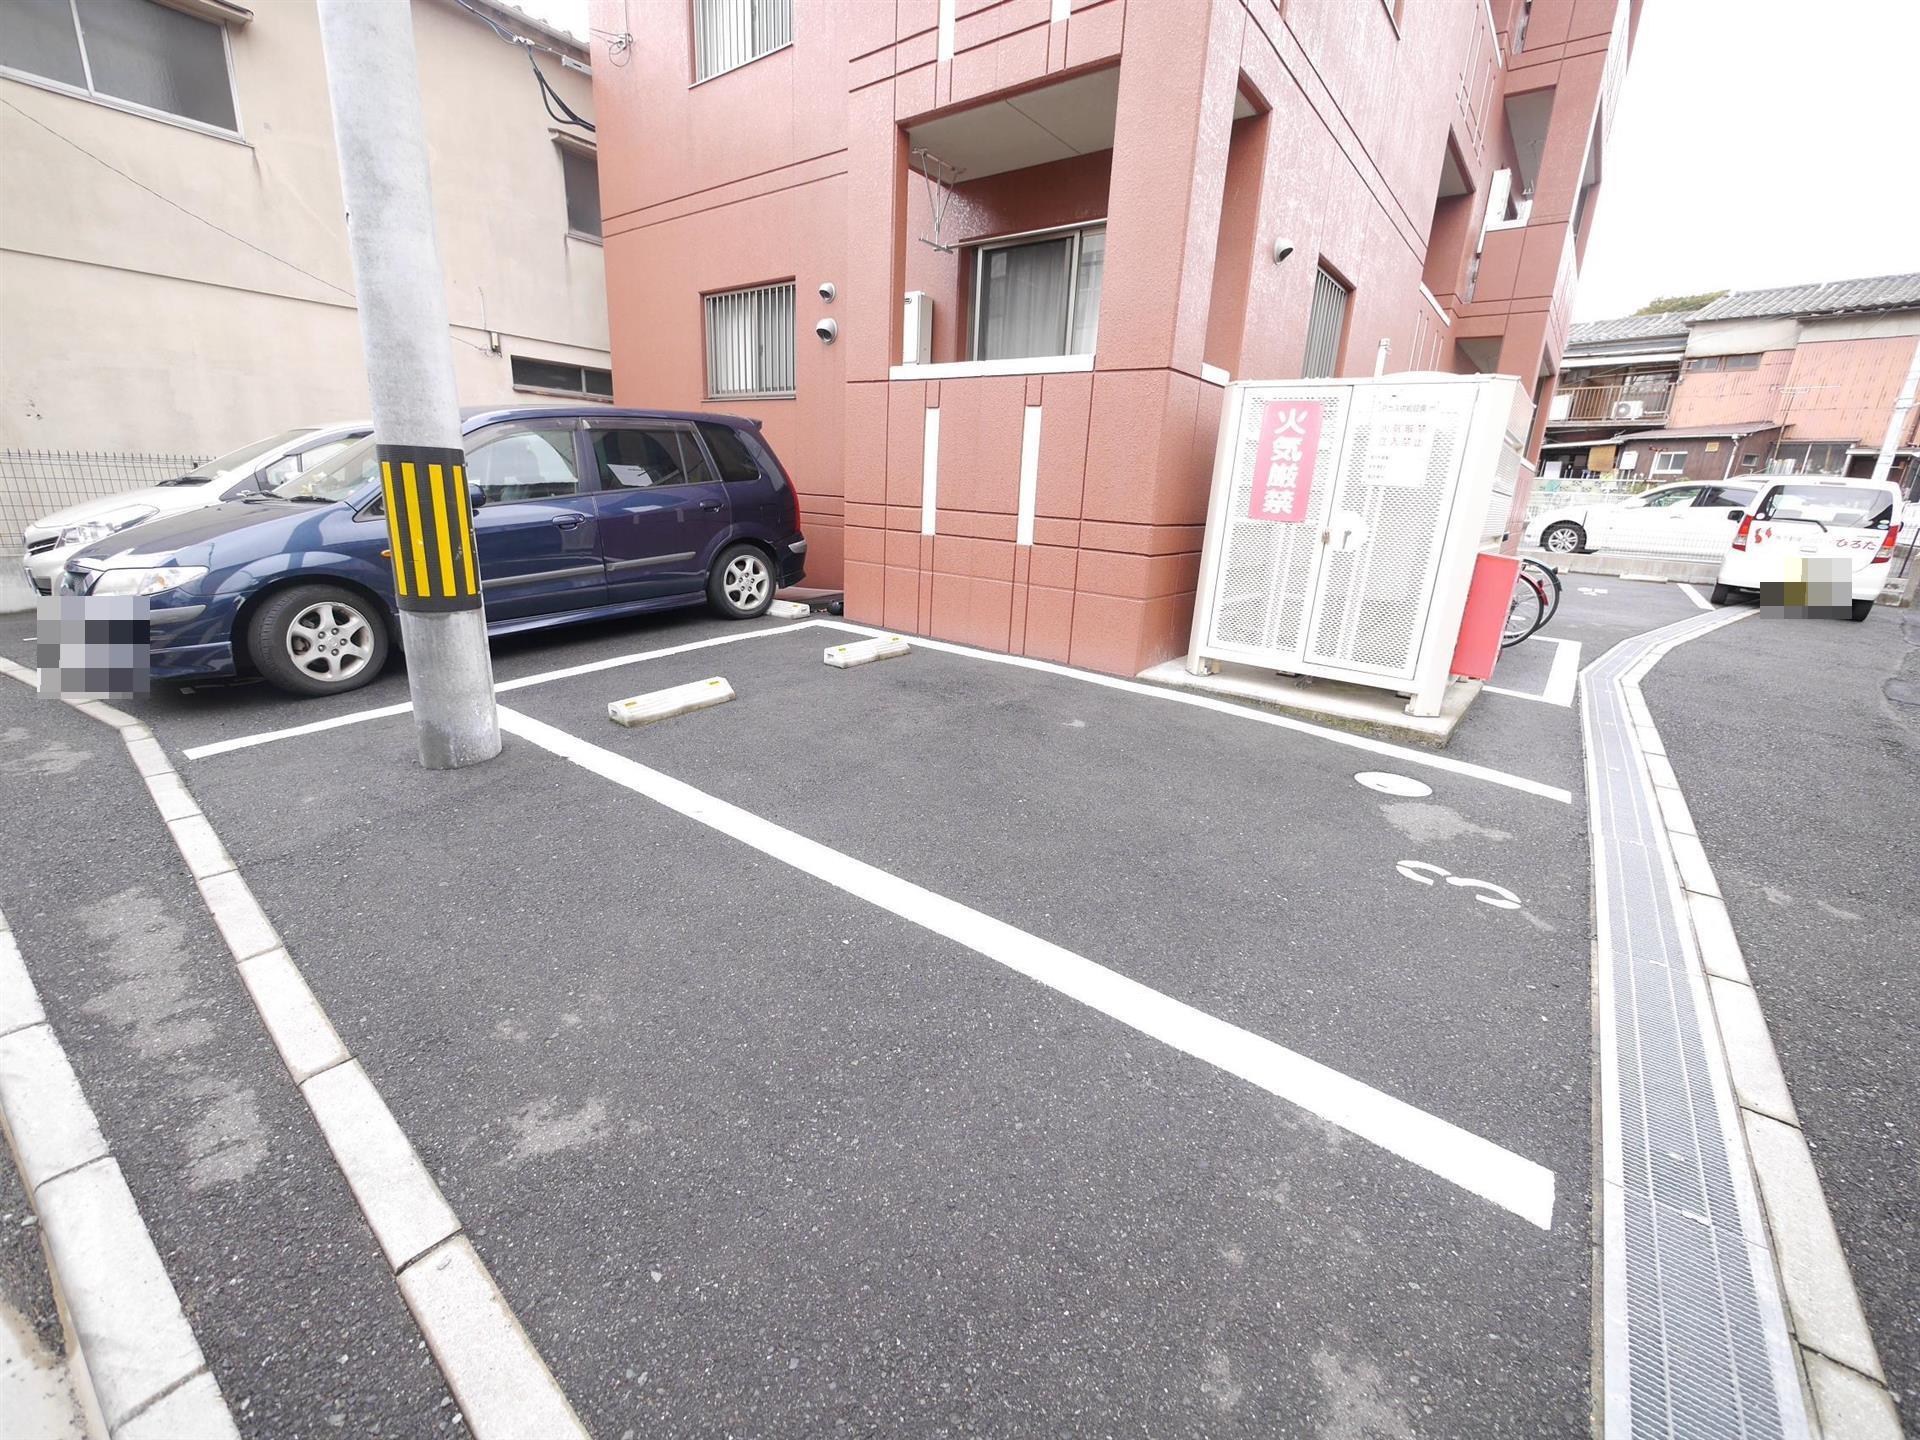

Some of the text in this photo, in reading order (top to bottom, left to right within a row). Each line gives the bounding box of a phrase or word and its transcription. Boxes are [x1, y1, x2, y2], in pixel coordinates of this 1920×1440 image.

[1263, 408, 1308, 514] 火気厳禁
[1837, 538, 1876, 551] ひろた
